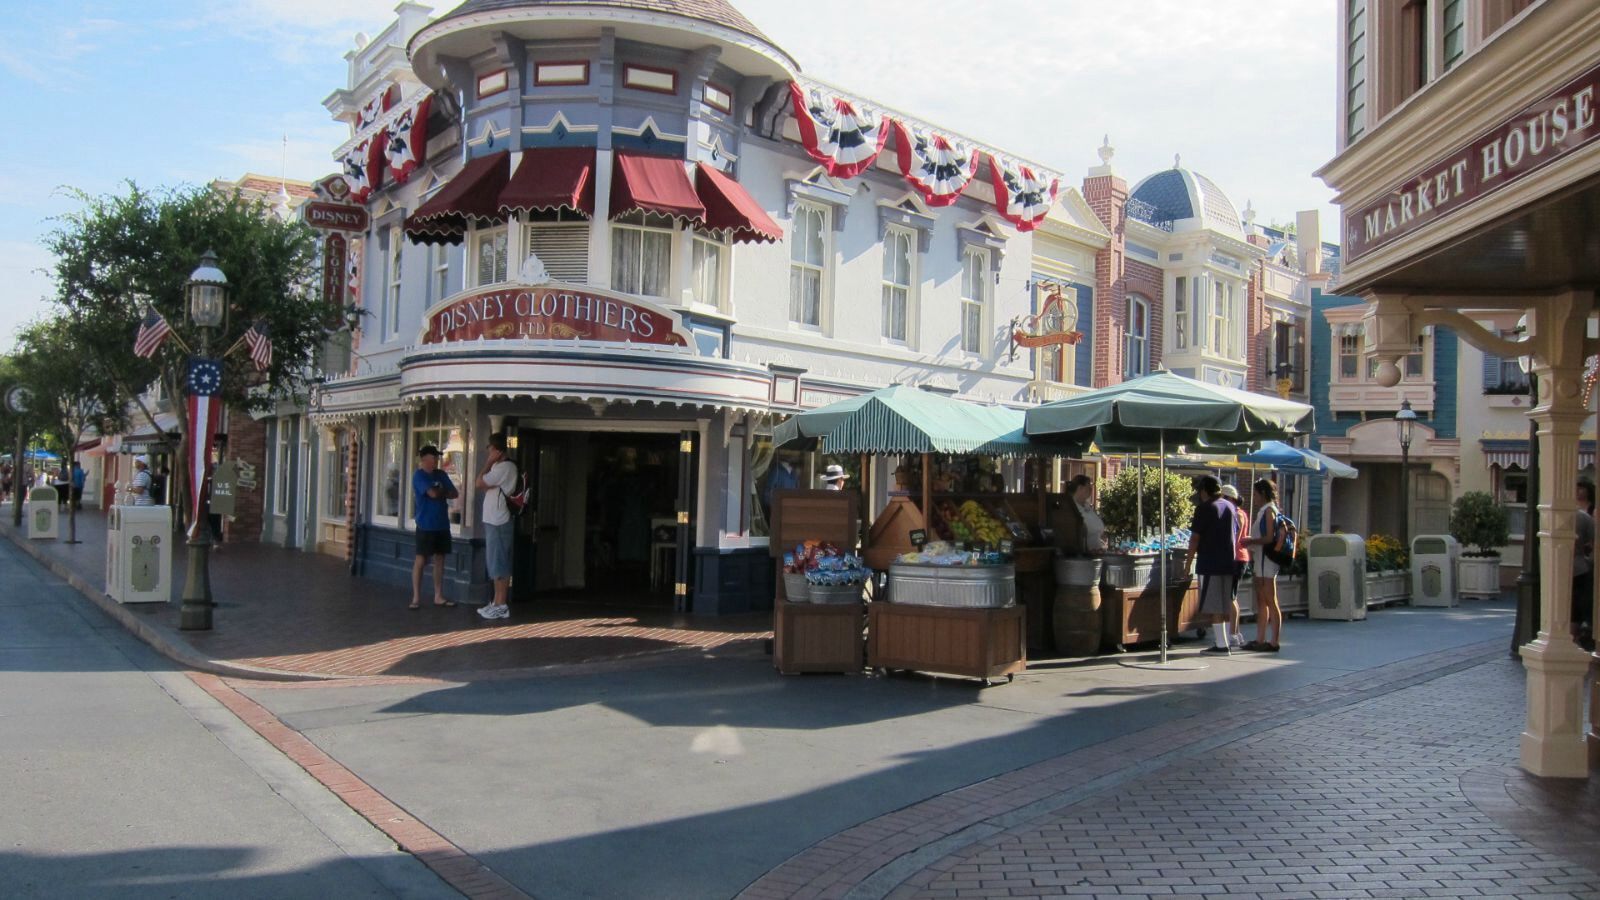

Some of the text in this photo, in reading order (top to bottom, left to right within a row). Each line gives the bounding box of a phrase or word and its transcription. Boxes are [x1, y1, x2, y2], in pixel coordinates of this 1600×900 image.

[1363, 85, 1595, 245] MARKET HOUSE
[311, 208, 361, 225] DISNEY
[440, 292, 655, 338] DISNEY CLOTHIERS
[519, 321, 546, 335] LTD
